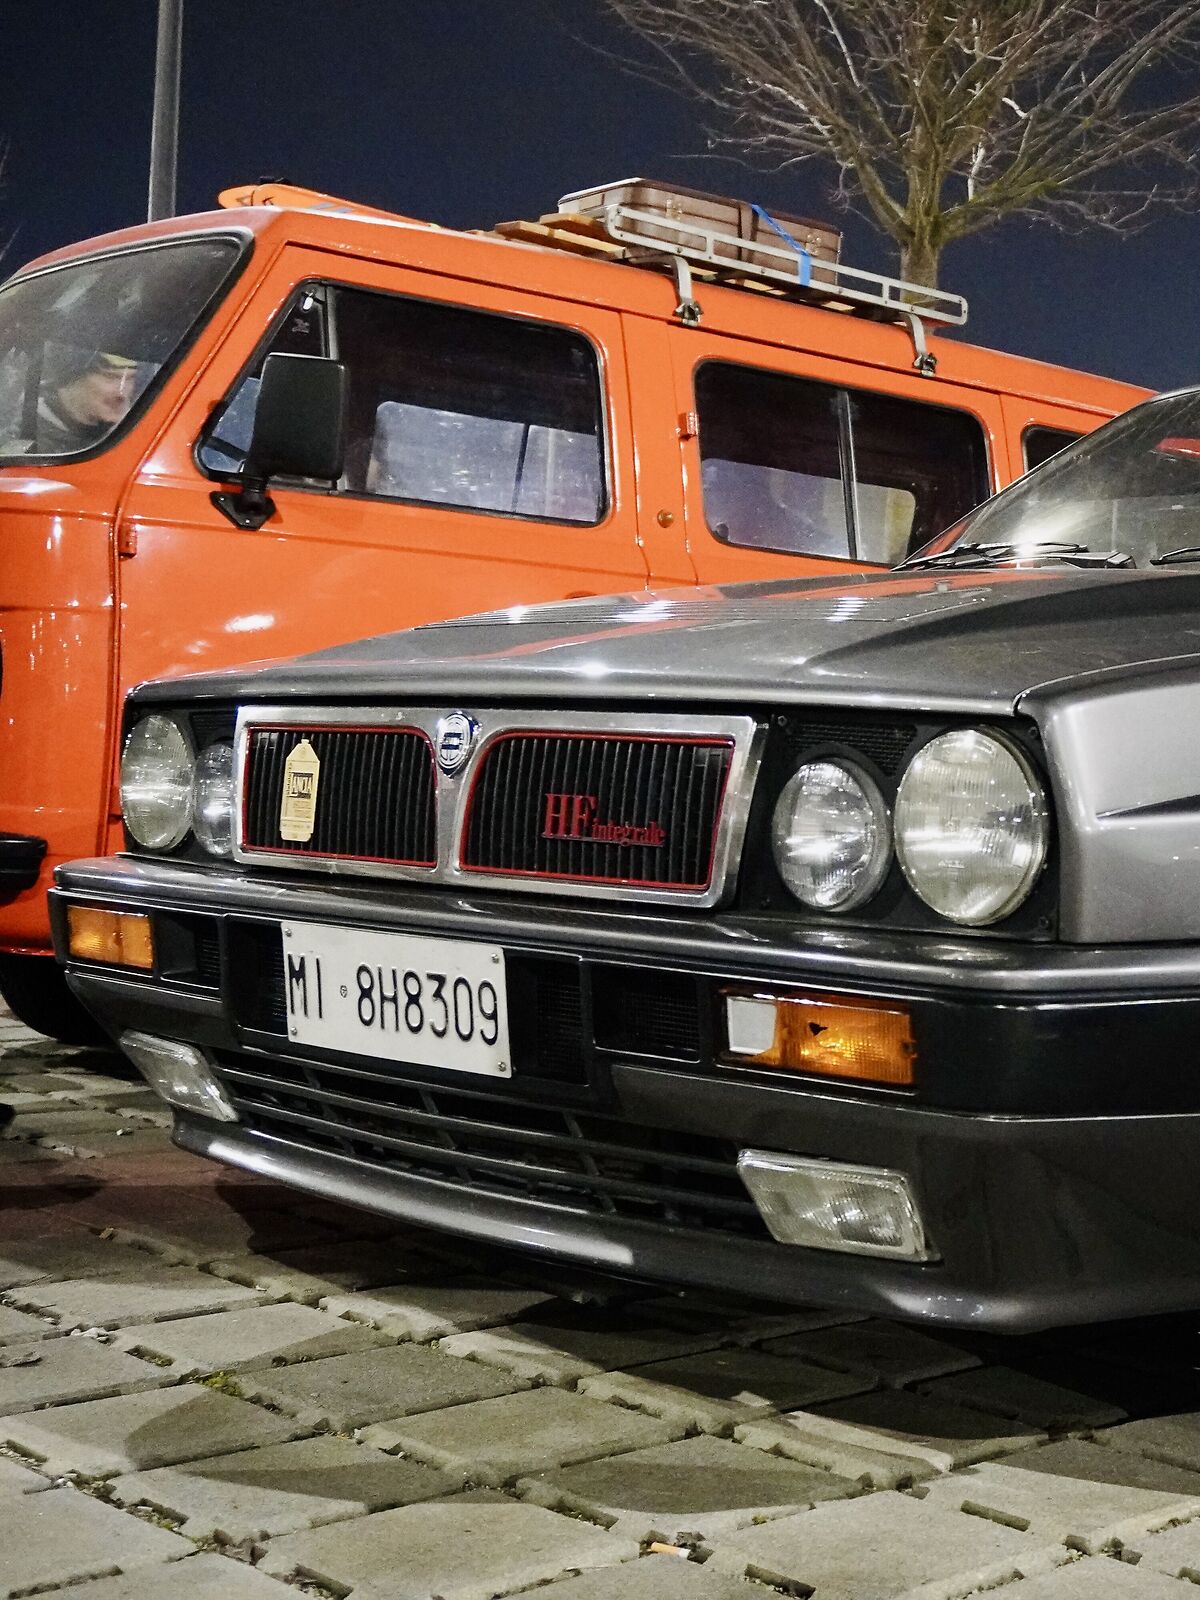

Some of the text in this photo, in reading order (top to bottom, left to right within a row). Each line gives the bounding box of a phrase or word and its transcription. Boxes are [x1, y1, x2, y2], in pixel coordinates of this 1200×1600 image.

[542, 793, 597, 838] HF
[287, 953, 498, 1046] MI 8H8309
